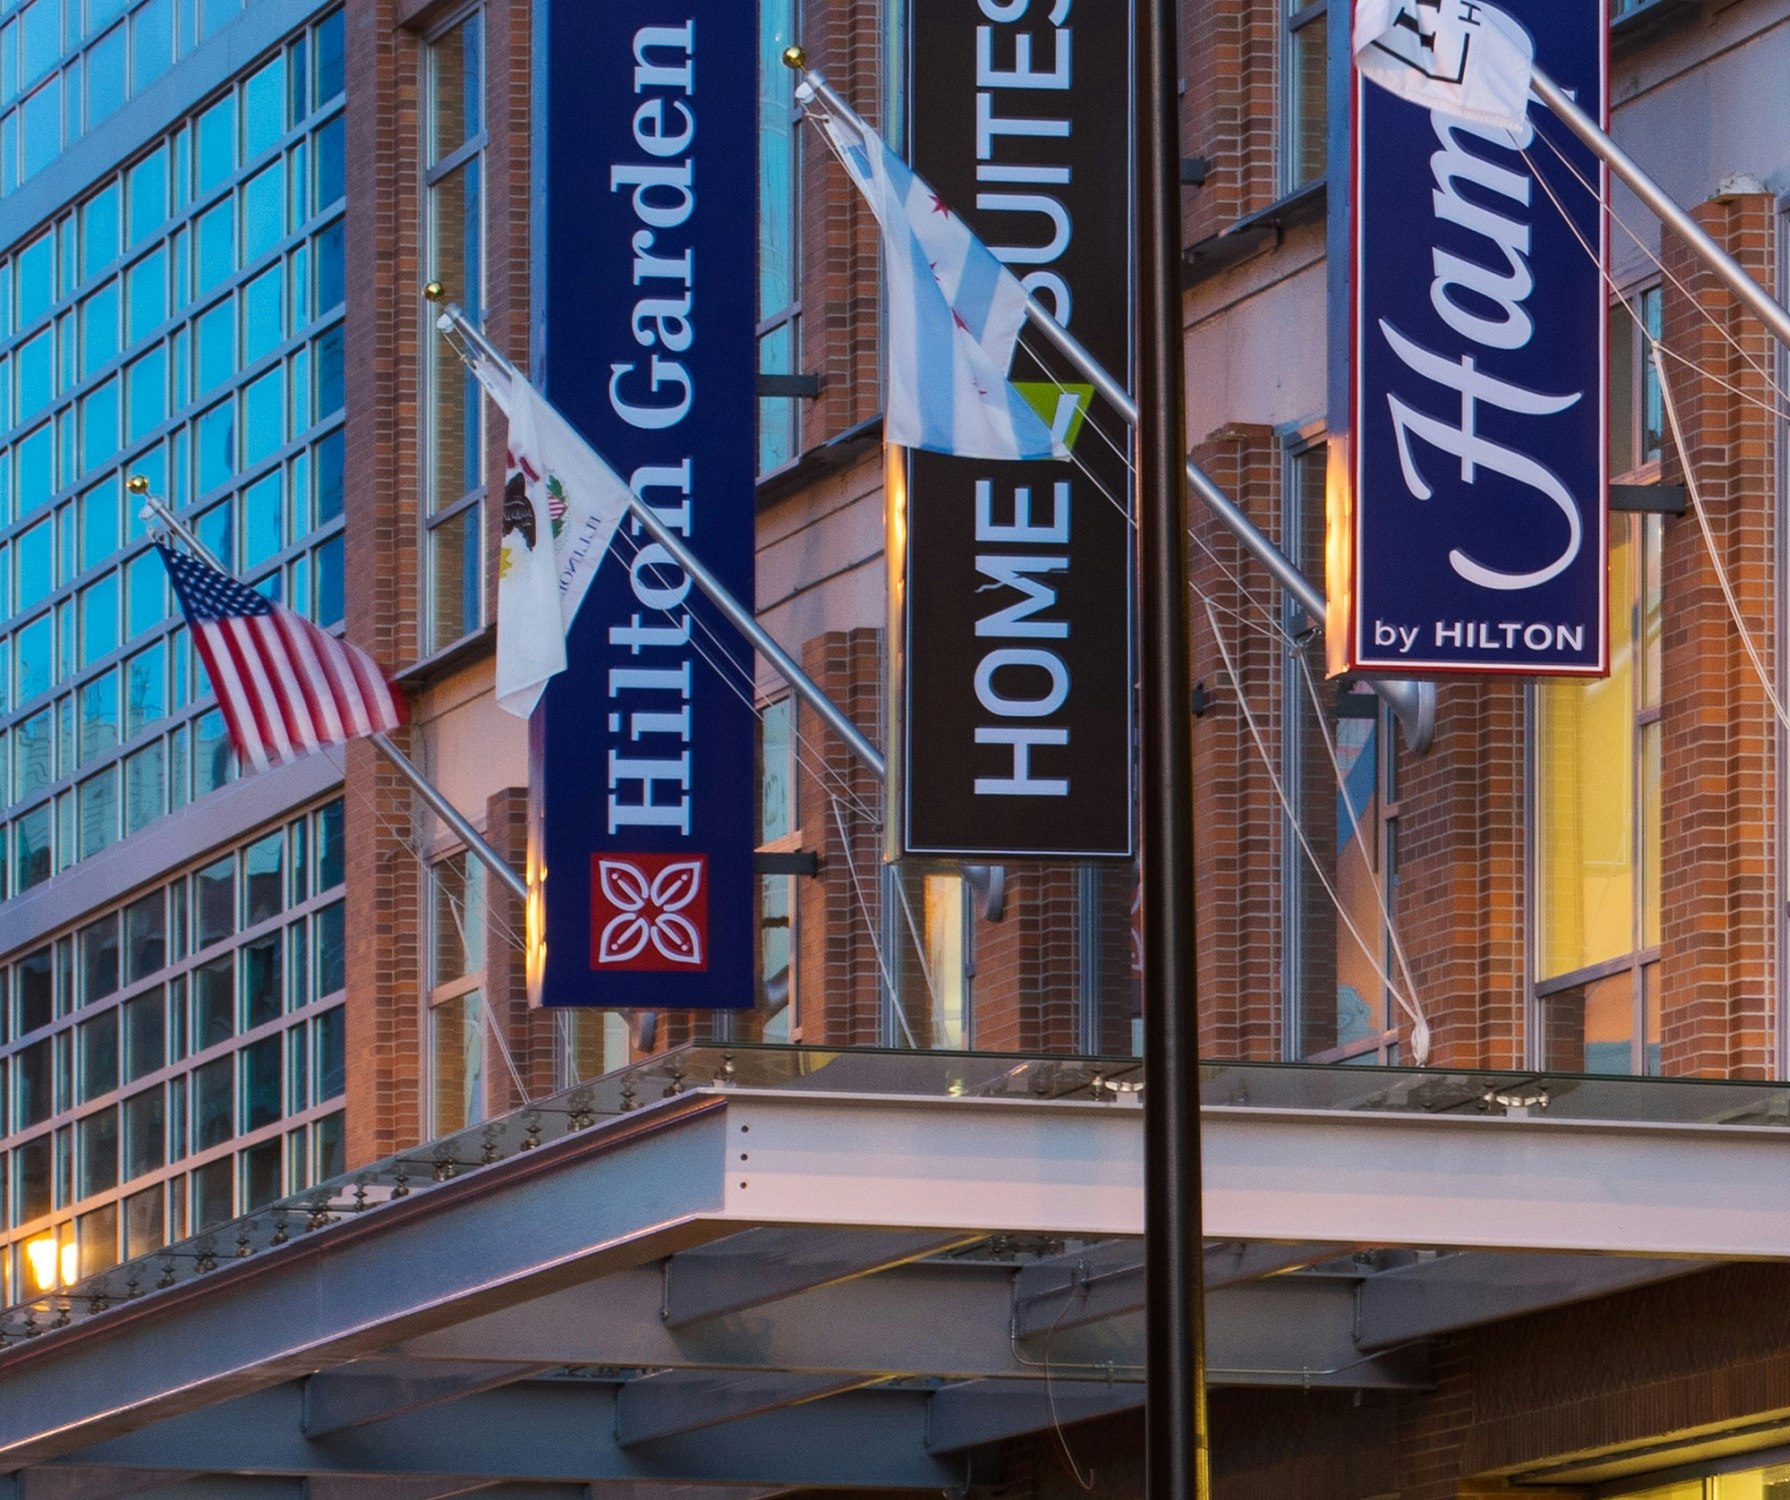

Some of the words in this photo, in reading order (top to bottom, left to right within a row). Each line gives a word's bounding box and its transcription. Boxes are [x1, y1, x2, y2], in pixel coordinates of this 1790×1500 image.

[607, 17, 697, 431] Garden
[607, 458, 692, 836] Hilton
[975, 478, 1070, 797] HOME
[1374, 619, 1419, 654] by
[1435, 620, 1584, 652] HILTON
